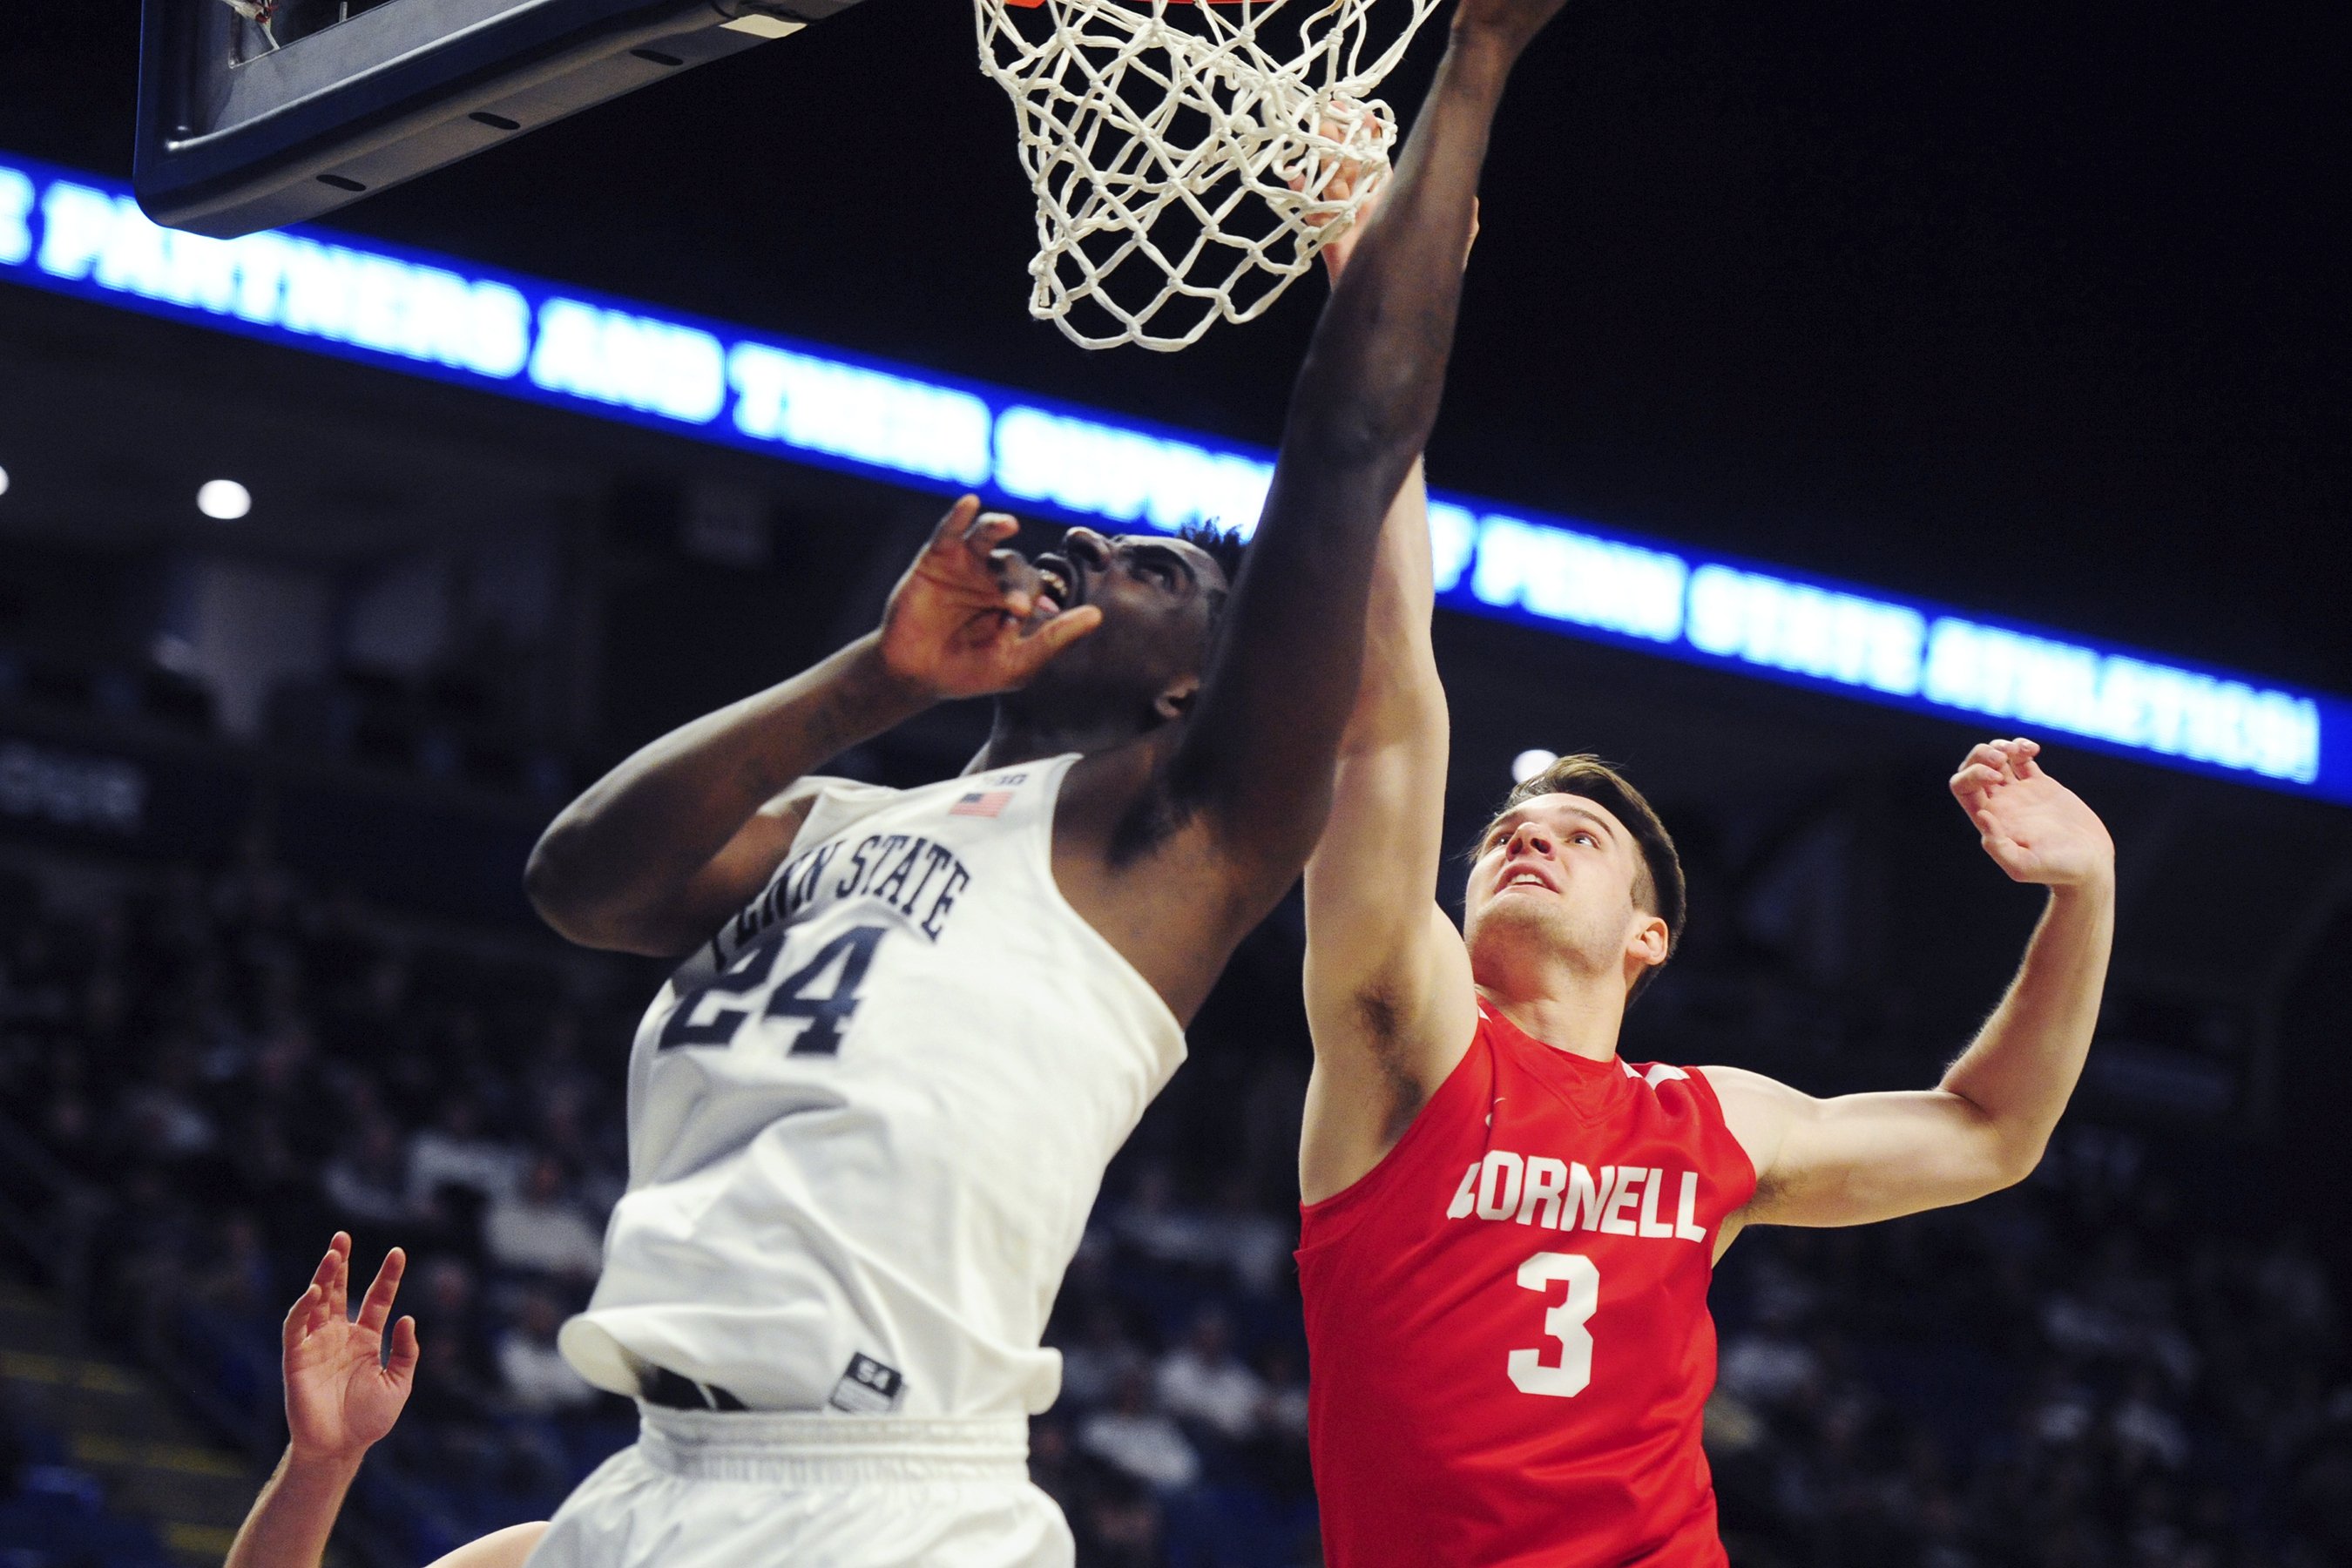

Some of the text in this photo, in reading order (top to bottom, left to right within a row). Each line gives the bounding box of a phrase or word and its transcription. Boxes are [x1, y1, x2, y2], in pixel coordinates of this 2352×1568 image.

[1687, 568, 1923, 693] STATE
[835, 834, 970, 943] STATE
[656, 925, 890, 1059] 24
[1507, 1251, 1600, 1398] 3
